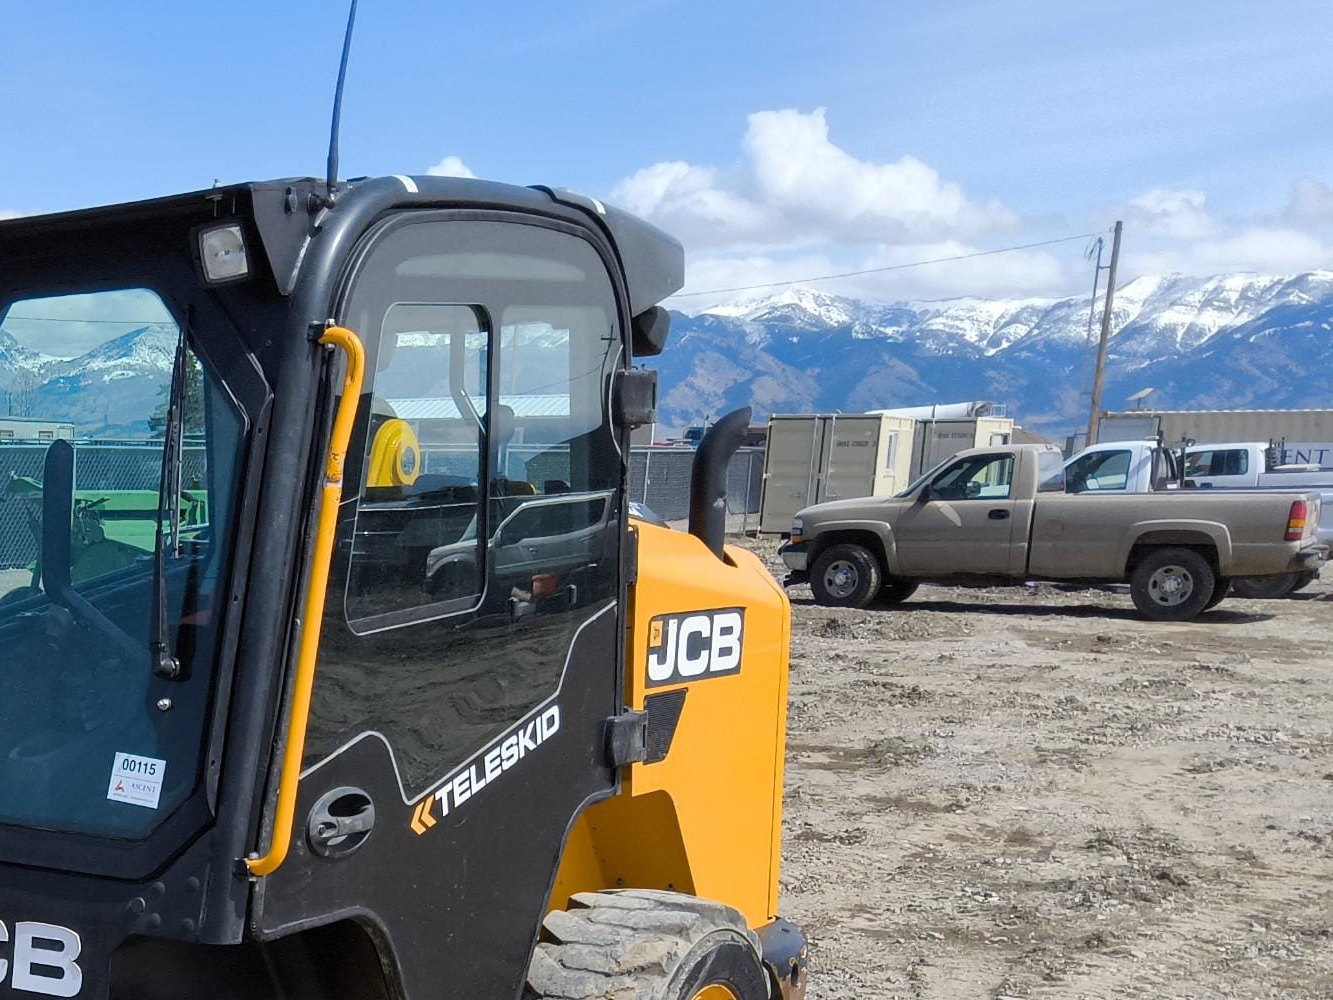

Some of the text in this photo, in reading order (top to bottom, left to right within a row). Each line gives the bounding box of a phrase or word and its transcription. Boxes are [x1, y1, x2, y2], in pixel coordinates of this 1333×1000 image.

[648, 612, 742, 681] JCB
[122, 758, 157, 776] 00115
[434, 704, 560, 817] TELESKID
